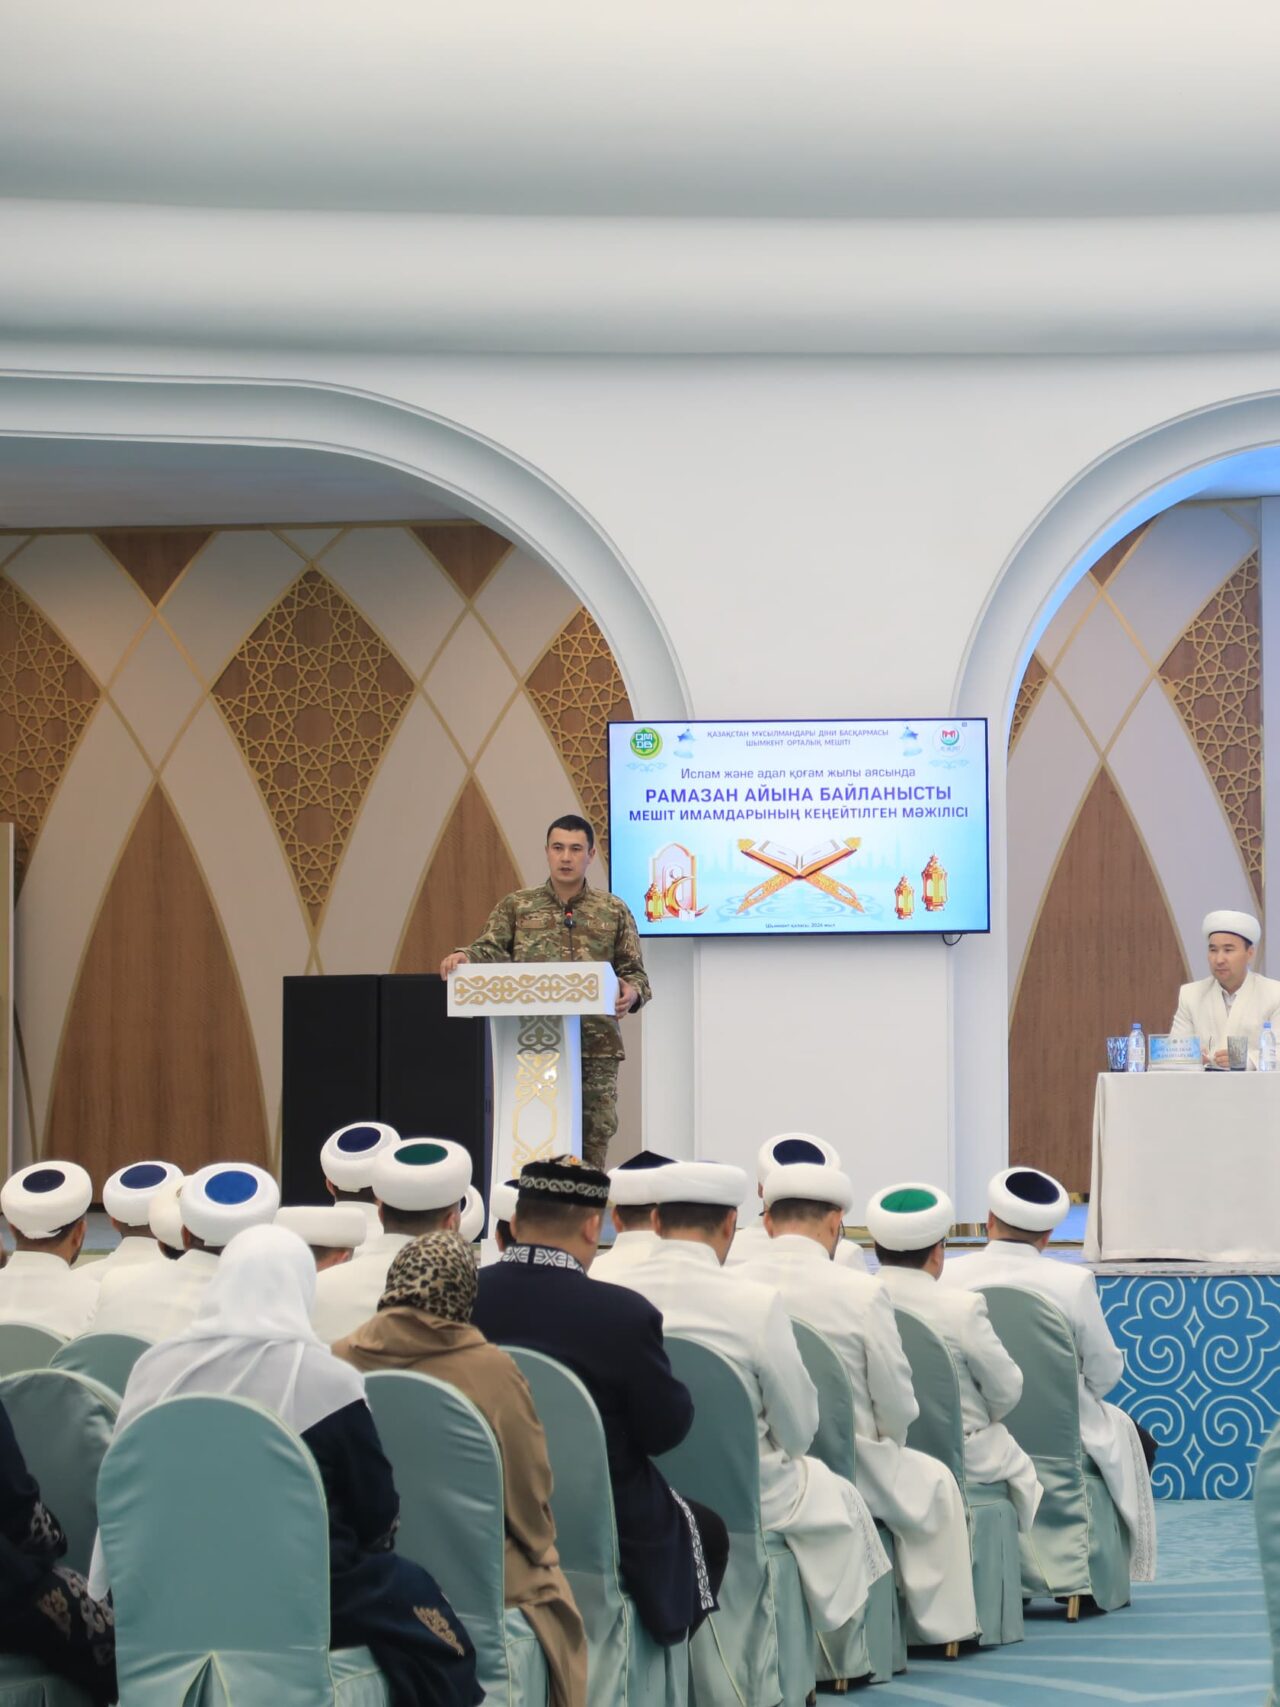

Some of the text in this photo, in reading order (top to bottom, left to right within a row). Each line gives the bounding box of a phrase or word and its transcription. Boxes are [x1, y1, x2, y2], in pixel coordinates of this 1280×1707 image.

[707, 730, 749, 738] ҚАЗАҚСТАН
[745, 739, 784, 747] ШЫМКЕНТ
[680, 767, 916, 780] Ислам және адал қоғам жылы аясында
[645, 782, 952, 804] РАМАЗАН АЙЫНА БАЙЛАНЫСТЫ
[628, 806, 969, 823] МЕШІТ ИМАМДАРЫНЫҢ КЕҢЕЙТІЛГЕН МӘЖІЛІСІ
